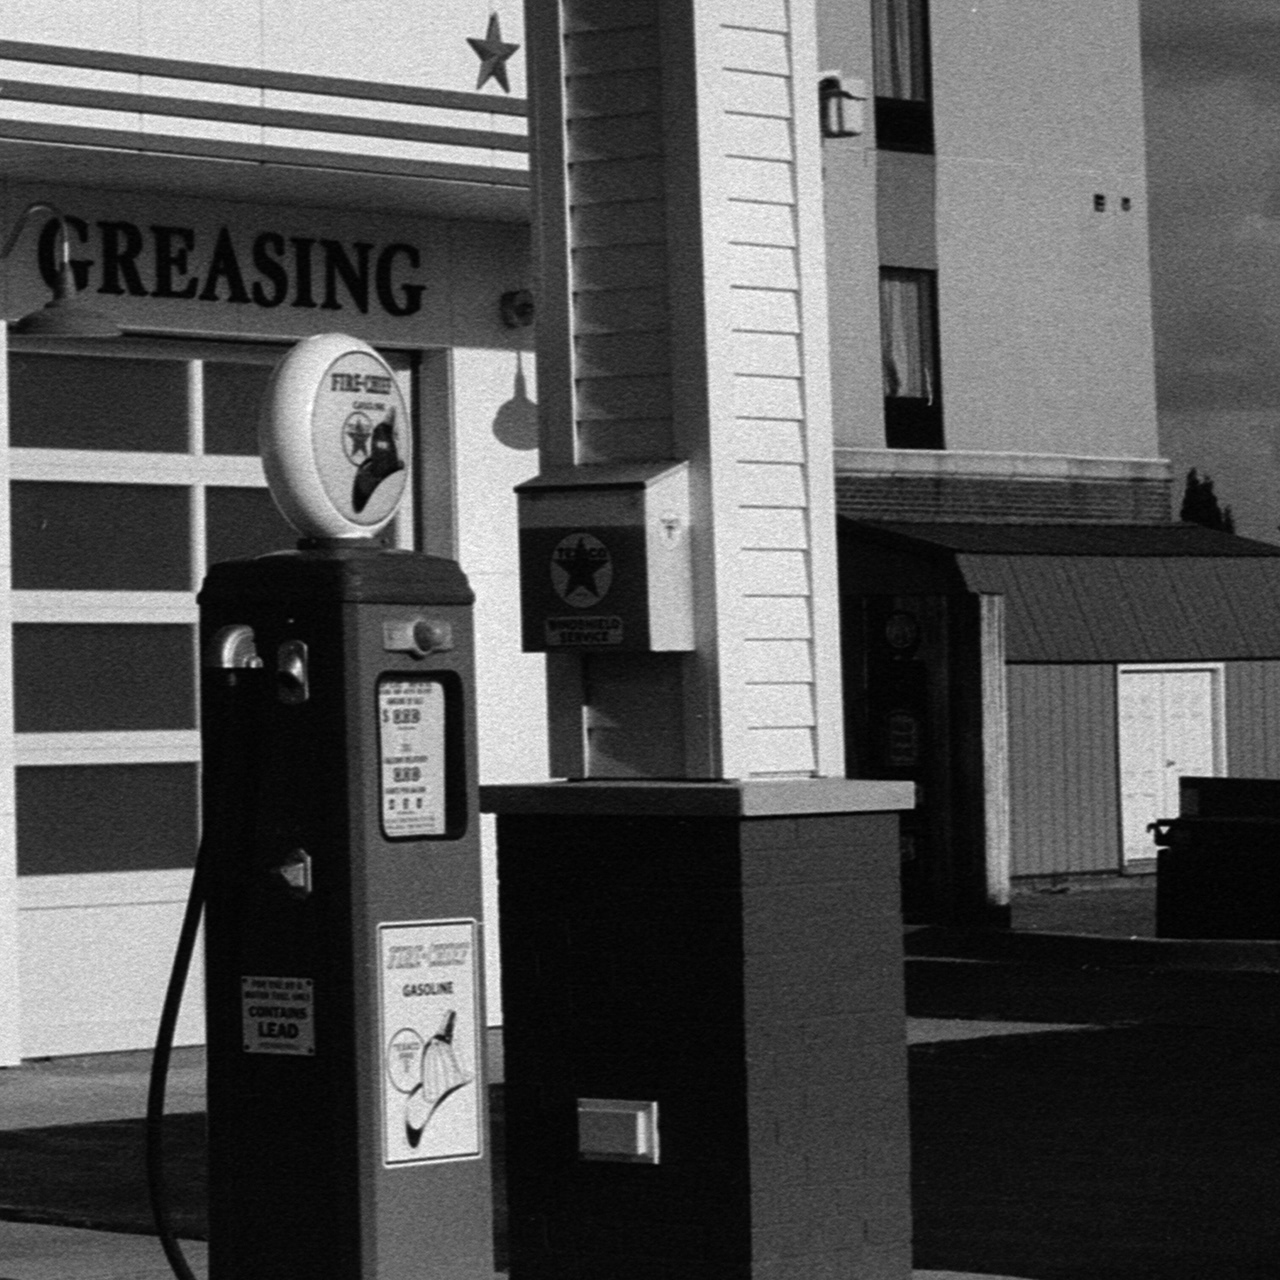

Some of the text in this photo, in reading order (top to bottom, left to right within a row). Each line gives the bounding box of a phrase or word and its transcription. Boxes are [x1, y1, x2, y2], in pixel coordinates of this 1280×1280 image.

[38, 214, 426, 318] GREASING
[557, 547, 608, 559] TEXCO
[559, 631, 608, 643] SERVICE
[402, 981, 454, 998] GASOLINE
[248, 1005, 308, 1020] CONTAINS
[258, 1022, 299, 1040] LEAD
